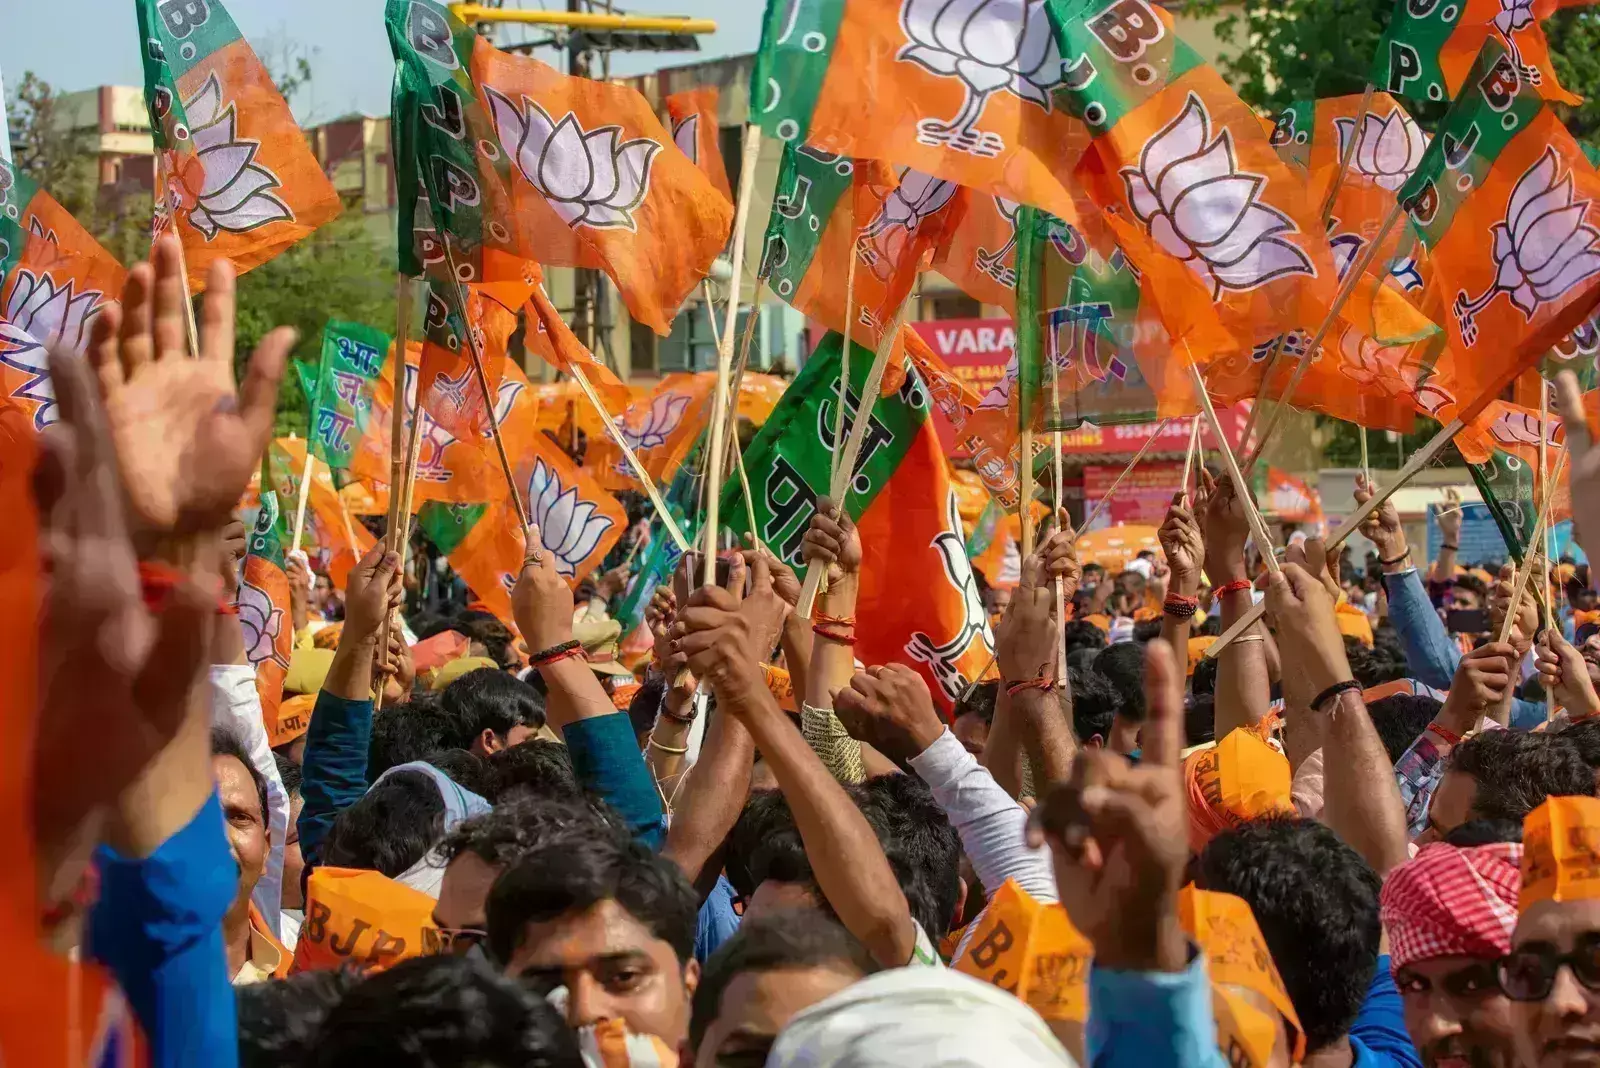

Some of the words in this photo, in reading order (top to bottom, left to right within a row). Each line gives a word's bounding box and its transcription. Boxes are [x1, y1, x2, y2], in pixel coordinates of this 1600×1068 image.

[1084, 0, 1165, 86] B.
[1387, 40, 1442, 101] P.
[1268, 107, 1308, 146] B.
[1477, 52, 1521, 131] B.
